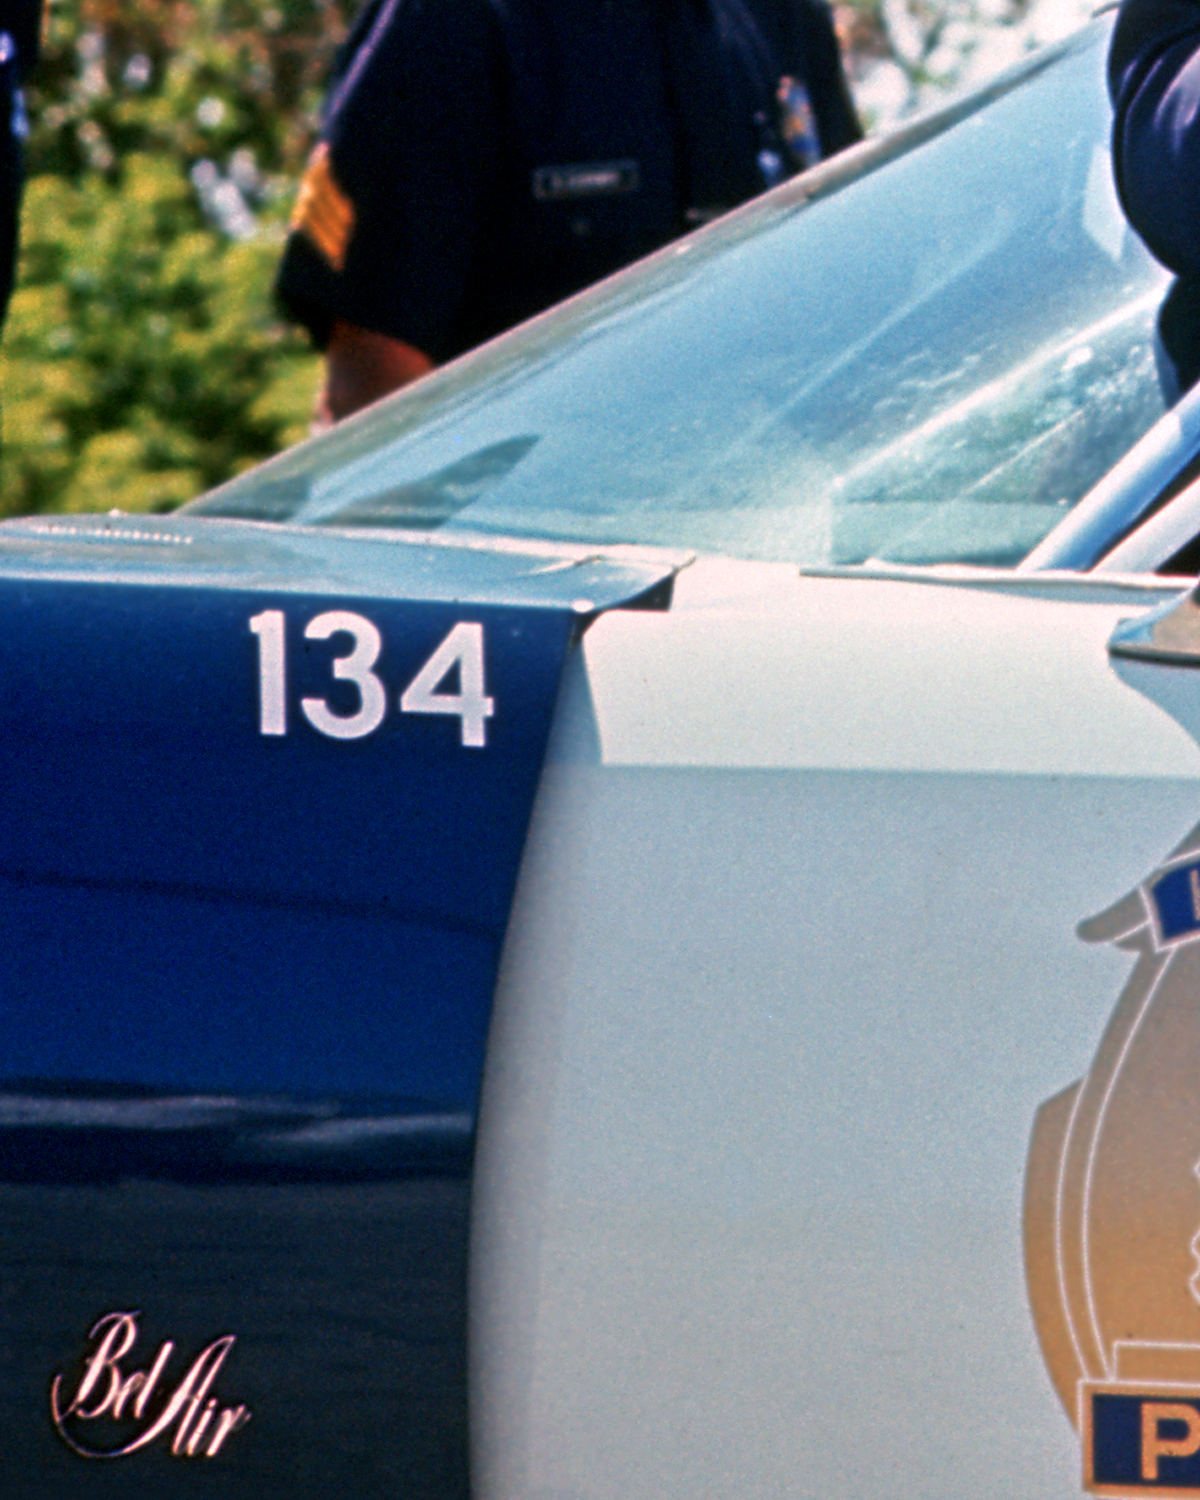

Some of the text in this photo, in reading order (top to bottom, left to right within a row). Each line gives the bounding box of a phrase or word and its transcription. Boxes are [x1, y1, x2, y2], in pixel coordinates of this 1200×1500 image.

[249, 609, 494, 748] 134
[51, 1310, 252, 1457] Bel Air
